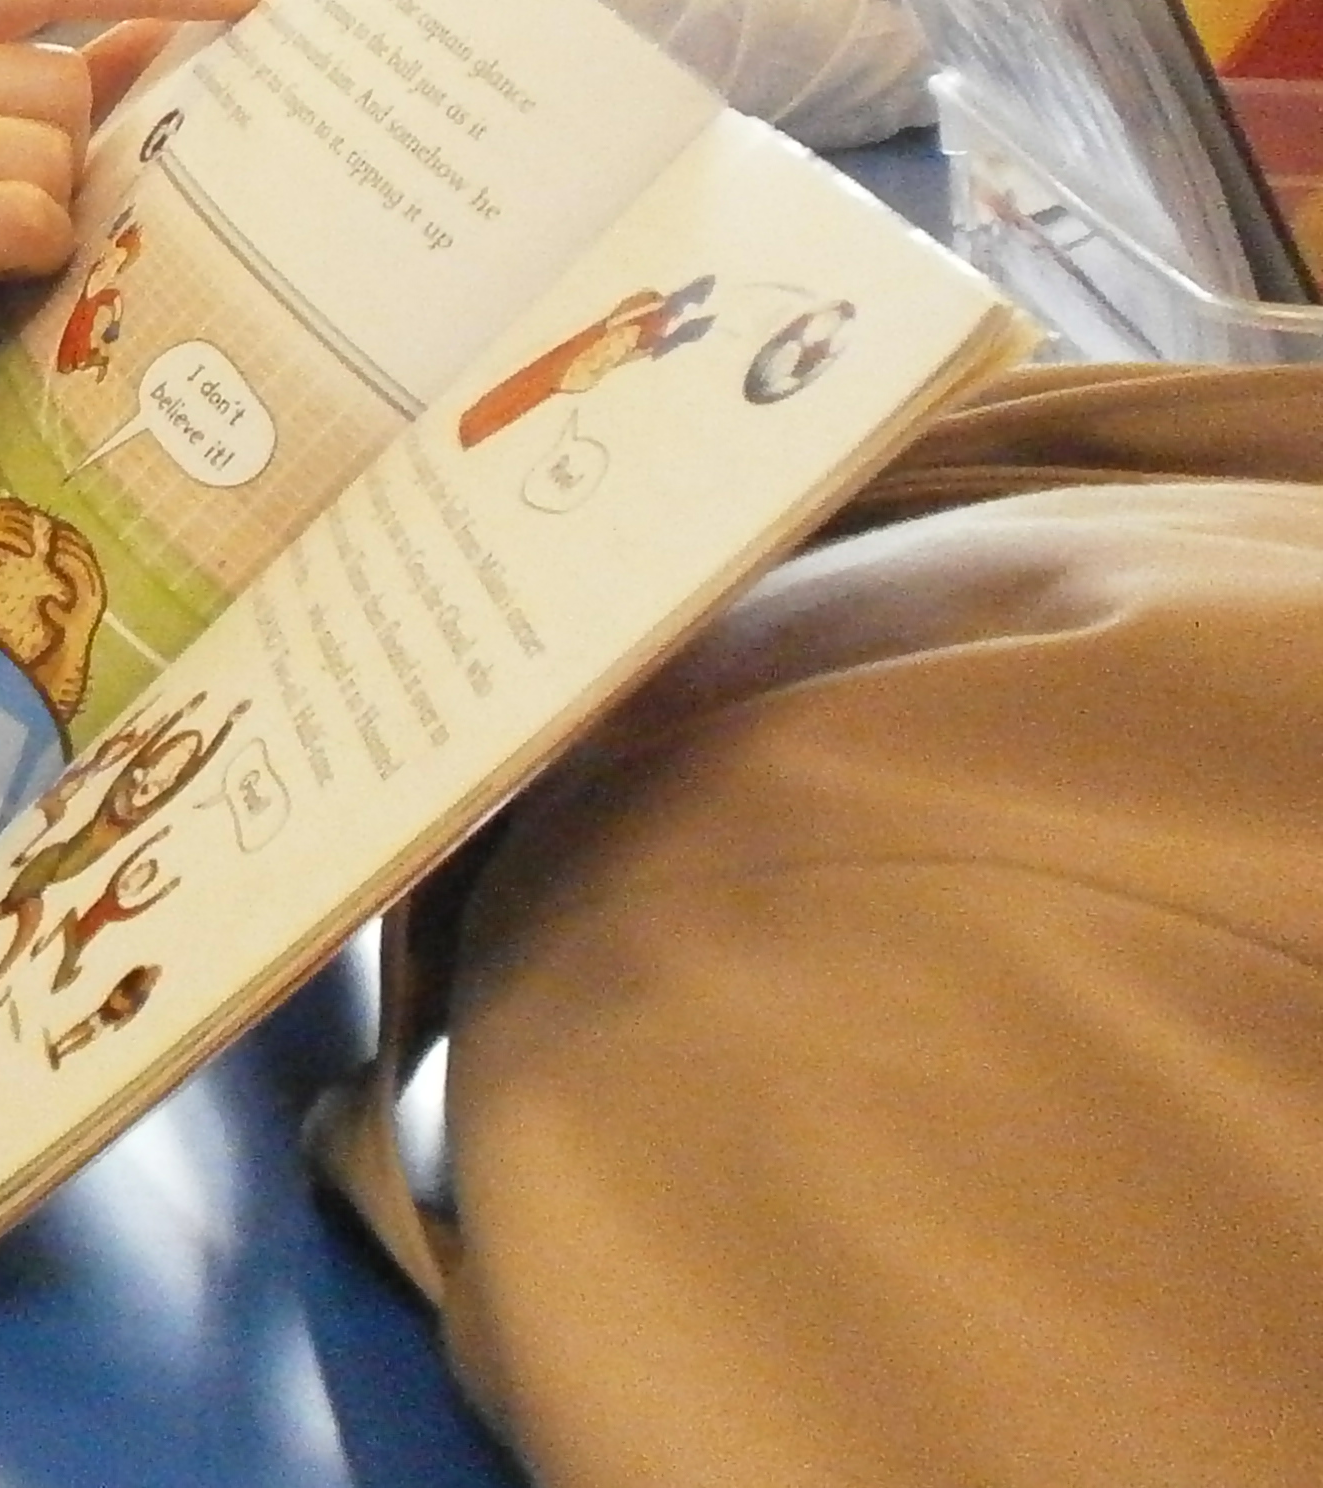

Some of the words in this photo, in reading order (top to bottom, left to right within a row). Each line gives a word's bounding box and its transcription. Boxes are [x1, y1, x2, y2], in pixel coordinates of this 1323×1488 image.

[386, 45, 423, 82] ball
[445, 104, 470, 126] as
[467, 118, 488, 142] it
[417, 13, 474, 62] captain
[468, 59, 537, 114] glance
[345, 149, 405, 210] tipping
[404, 198, 423, 223] it
[422, 221, 454, 250] up
[354, 88, 395, 124] And
[386, 119, 465, 192] somehow
[470, 185, 501, 220] he
[150, 380, 205, 445] believe
[203, 439, 236, 472] it!
[186, 363, 206, 382] I
[199, 380, 247, 427] don't
